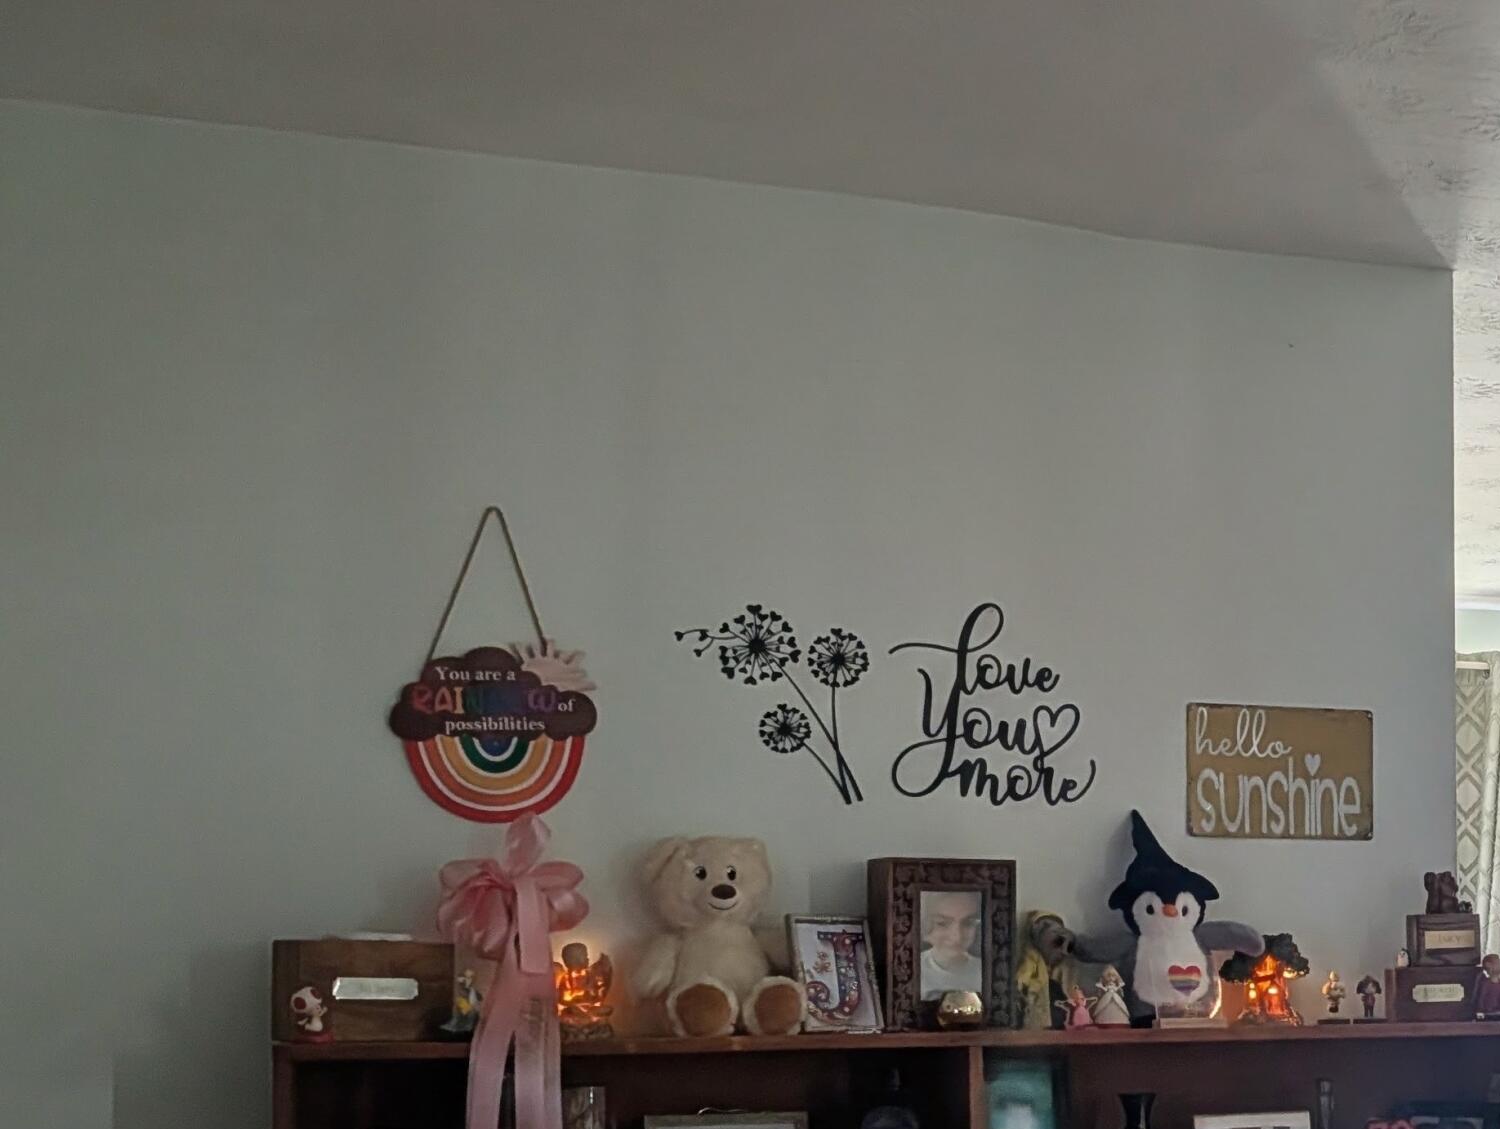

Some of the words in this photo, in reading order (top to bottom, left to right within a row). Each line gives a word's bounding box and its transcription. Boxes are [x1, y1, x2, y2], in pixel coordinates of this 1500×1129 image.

[435, 666, 470, 681] You
[474, 669, 501, 681] are
[506, 670, 516, 681] a
[557, 699, 575, 712] of
[445, 717, 546, 734] possibilities
[1195, 706, 1293, 758] hello
[955, 756, 1096, 806] more
[1197, 756, 1361, 836] sunshine
